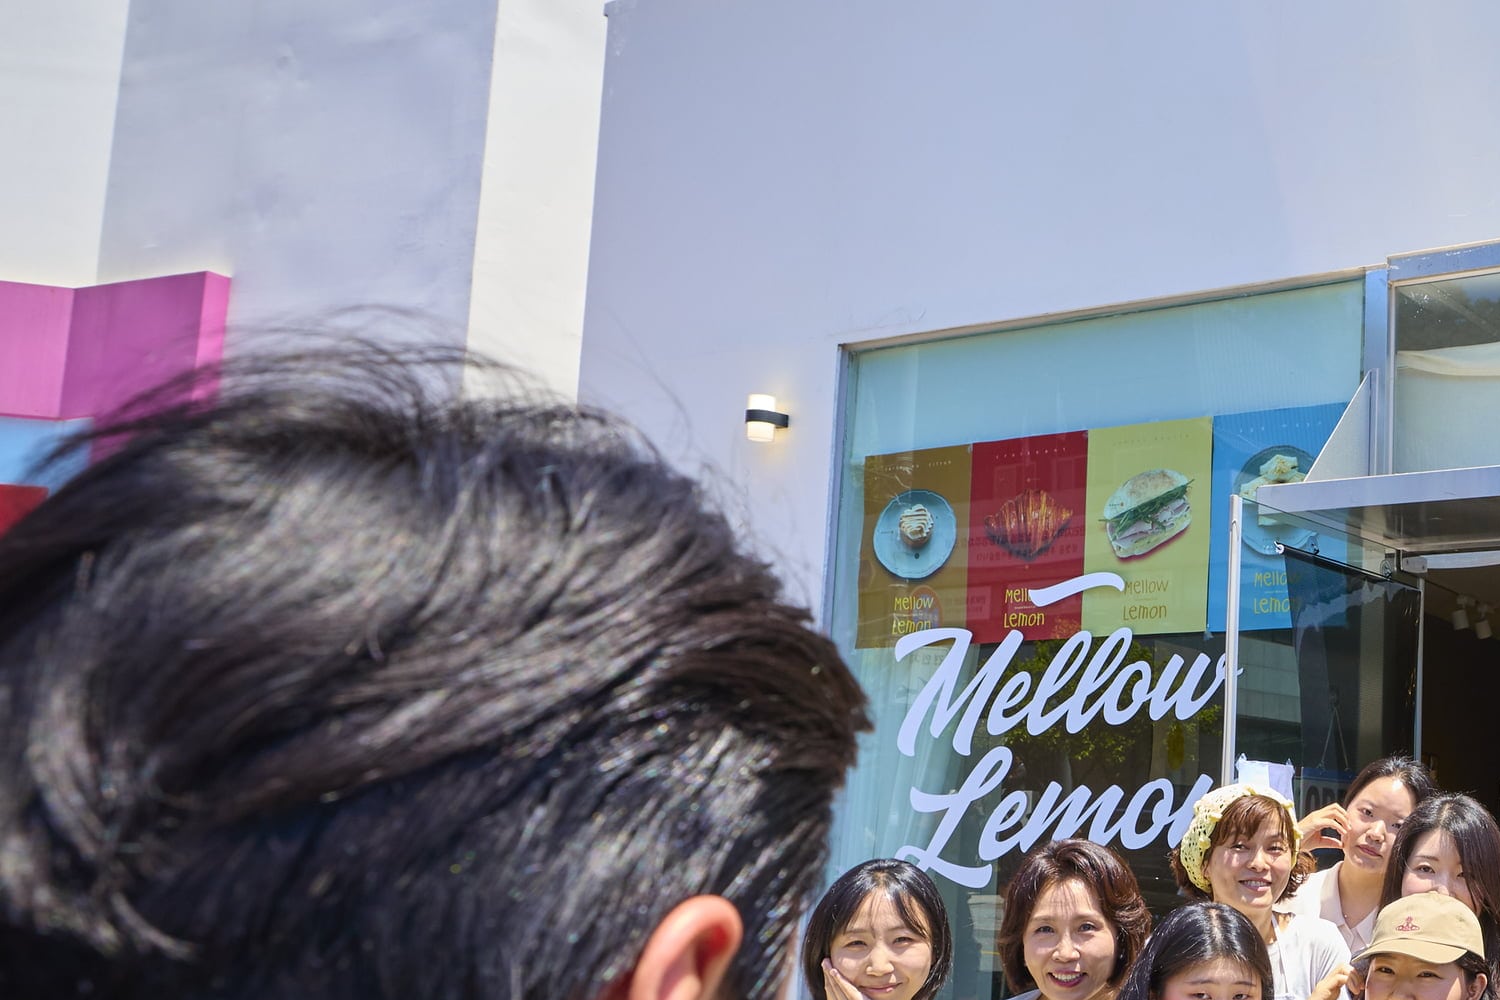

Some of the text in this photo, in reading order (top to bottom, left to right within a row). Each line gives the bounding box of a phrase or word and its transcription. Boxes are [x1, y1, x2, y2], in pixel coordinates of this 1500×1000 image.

[1123, 579, 1169, 595] Mellow
[1254, 571, 1288, 588] Mello
[894, 596, 935, 611] Mellow
[1004, 588, 1032, 604] Mell
[1122, 605, 1167, 621] Lemon
[1253, 597, 1291, 615] Lemo
[891, 620, 931, 635] Lemon
[1003, 611, 1045, 629] Lemon
[894, 626, 1244, 757] Mellow
